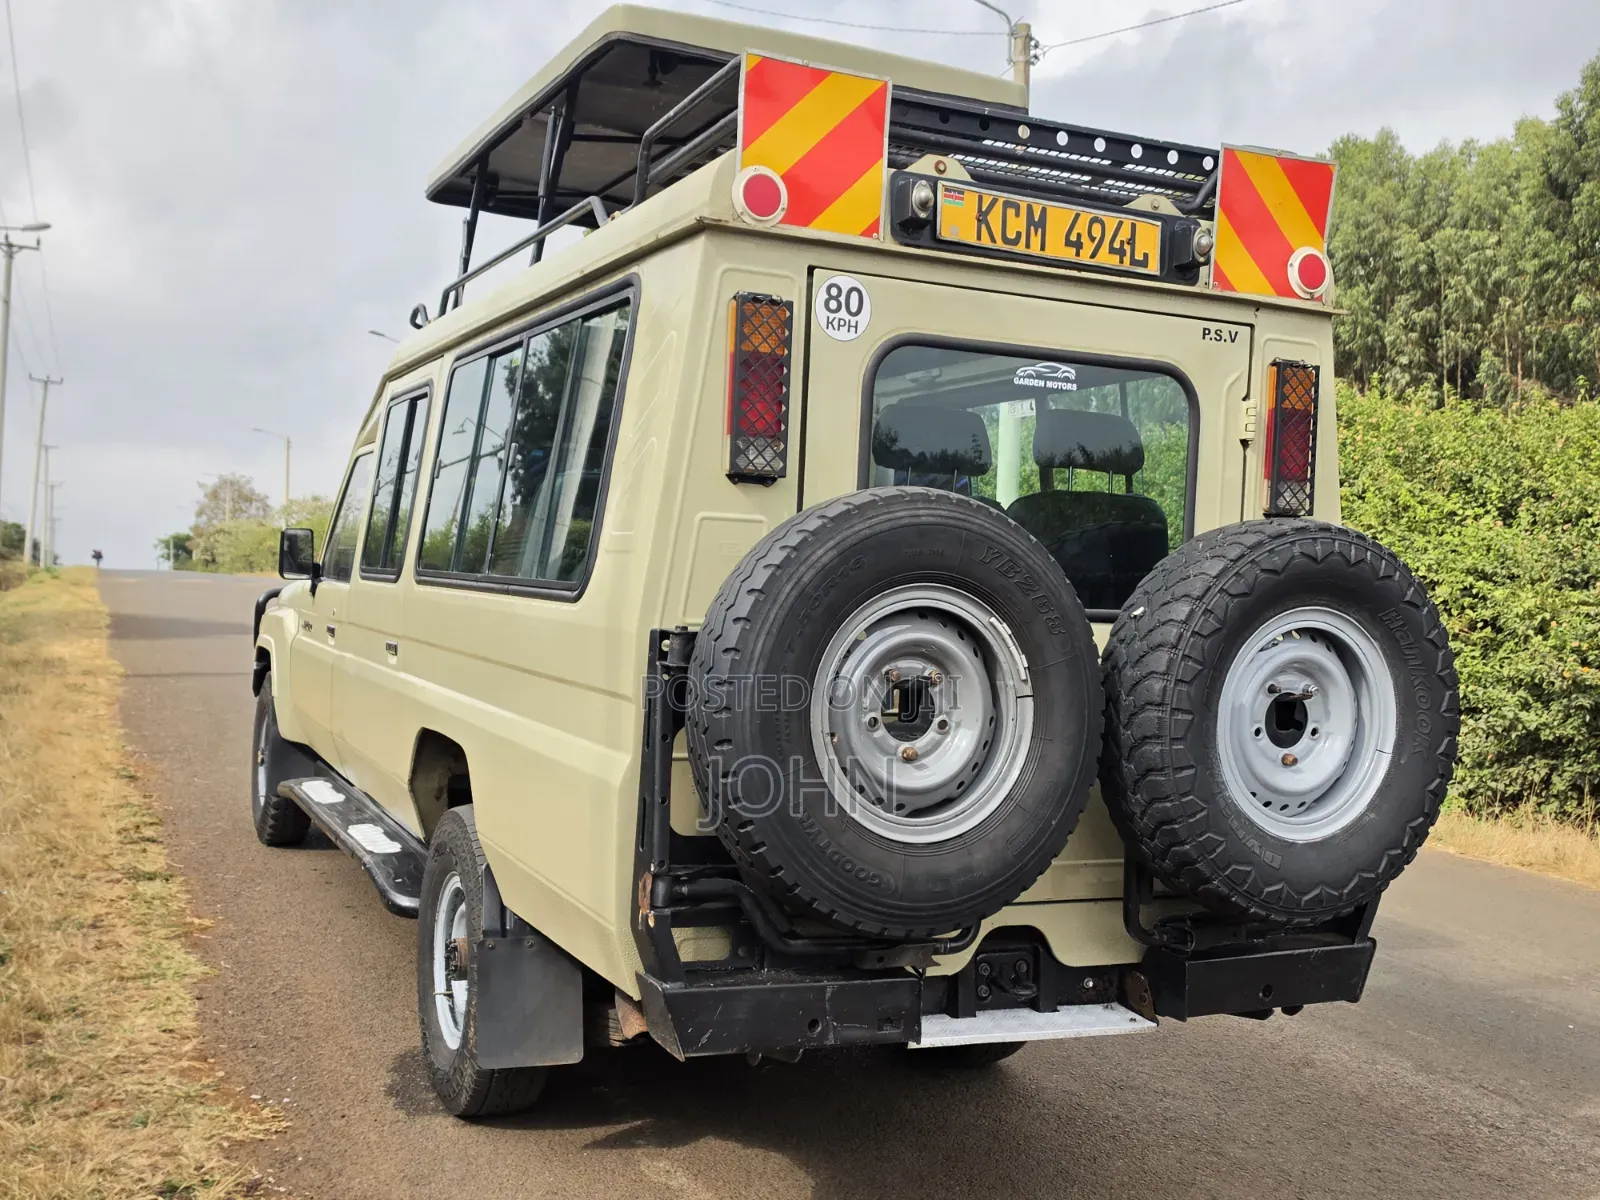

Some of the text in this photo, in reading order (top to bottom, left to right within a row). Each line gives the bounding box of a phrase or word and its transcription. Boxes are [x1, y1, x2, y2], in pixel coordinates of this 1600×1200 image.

[976, 195, 1149, 268] KCM 494L
[824, 283, 863, 317] 80
[826, 316, 858, 334] KPH
[1013, 377, 1077, 391] GARDEN MOTORS
